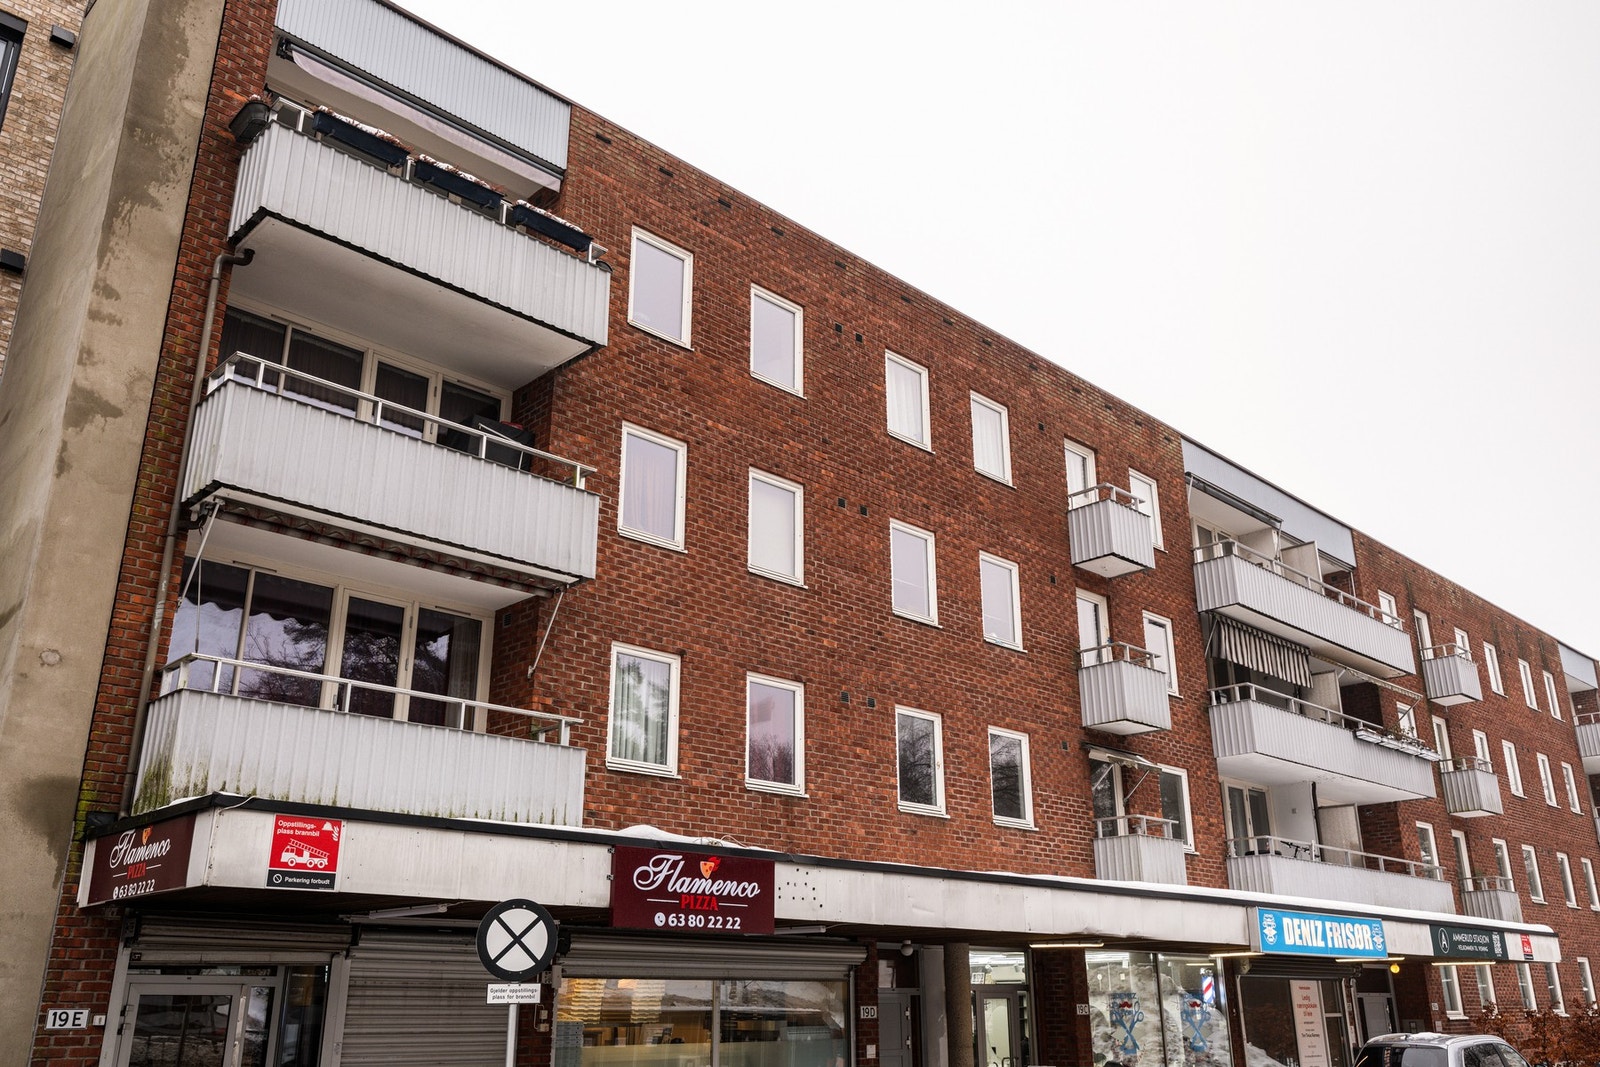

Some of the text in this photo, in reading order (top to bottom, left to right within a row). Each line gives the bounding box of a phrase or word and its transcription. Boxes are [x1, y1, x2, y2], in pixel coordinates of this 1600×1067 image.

[295, 829, 320, 837] brannbil
[109, 829, 171, 868] Flamenco
[127, 862, 147, 880] PIZZA
[633, 854, 760, 898] Flamenco
[285, 876, 310, 885] Parkering
[119, 885, 127, 898] 63
[681, 894, 719, 911] PIZZA
[668, 913, 741, 930] 63 80 22 22
[1282, 917, 1373, 950] DENIZ FRISØR
[52, 1011, 83, 1027] 19 E
